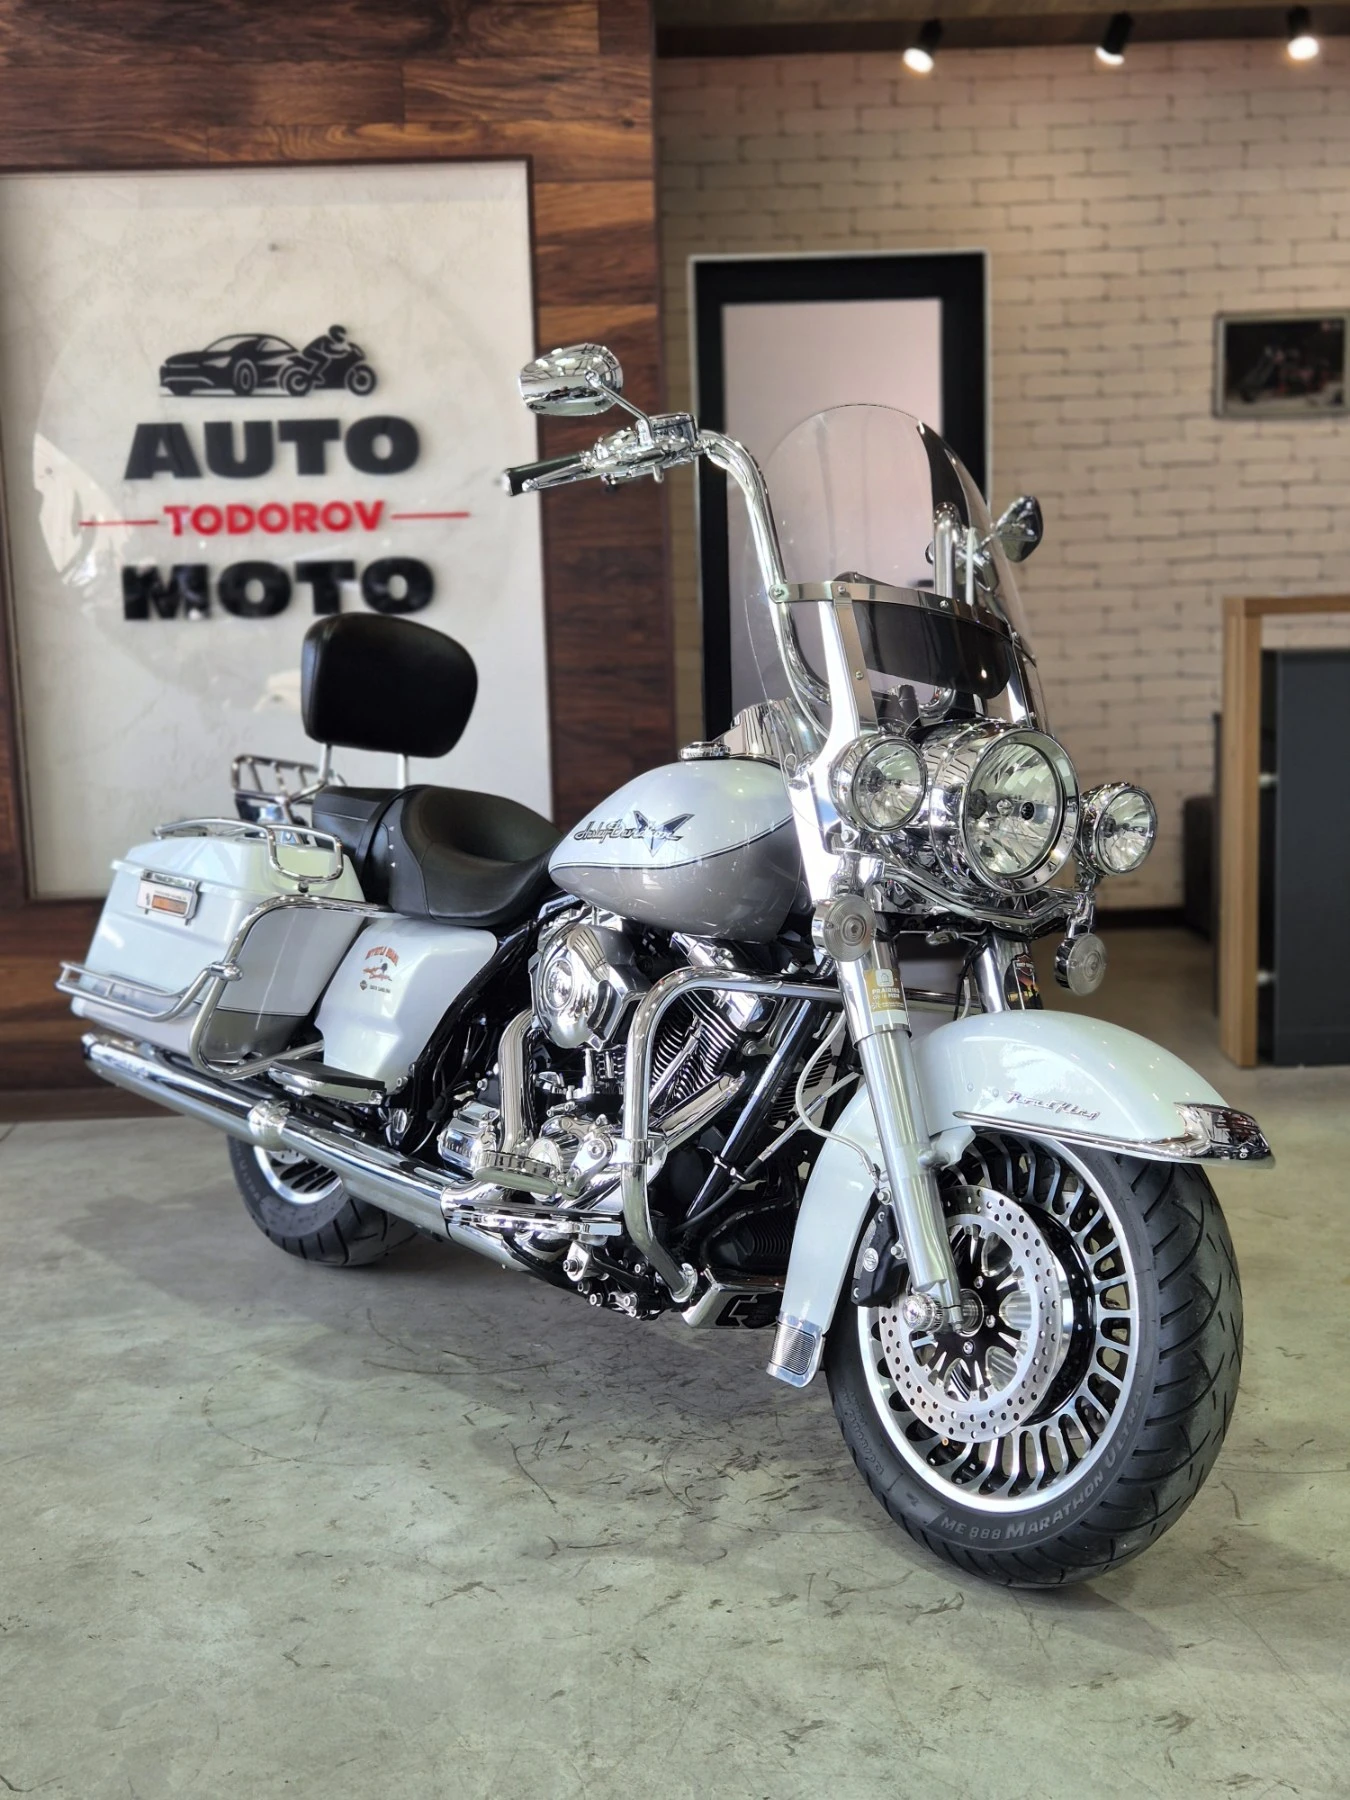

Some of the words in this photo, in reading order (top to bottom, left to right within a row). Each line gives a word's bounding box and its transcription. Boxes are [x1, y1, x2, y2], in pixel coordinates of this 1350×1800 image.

[124, 415, 420, 480] AUTO
[163, 500, 386, 536] TODOROV
[121, 557, 435, 621] MOTO
[940, 1515, 968, 1535] ME
[969, 1526, 1001, 1540] 888
[1004, 1470, 1105, 1540] MARATHON
[1104, 1390, 1142, 1469] ULTRA
